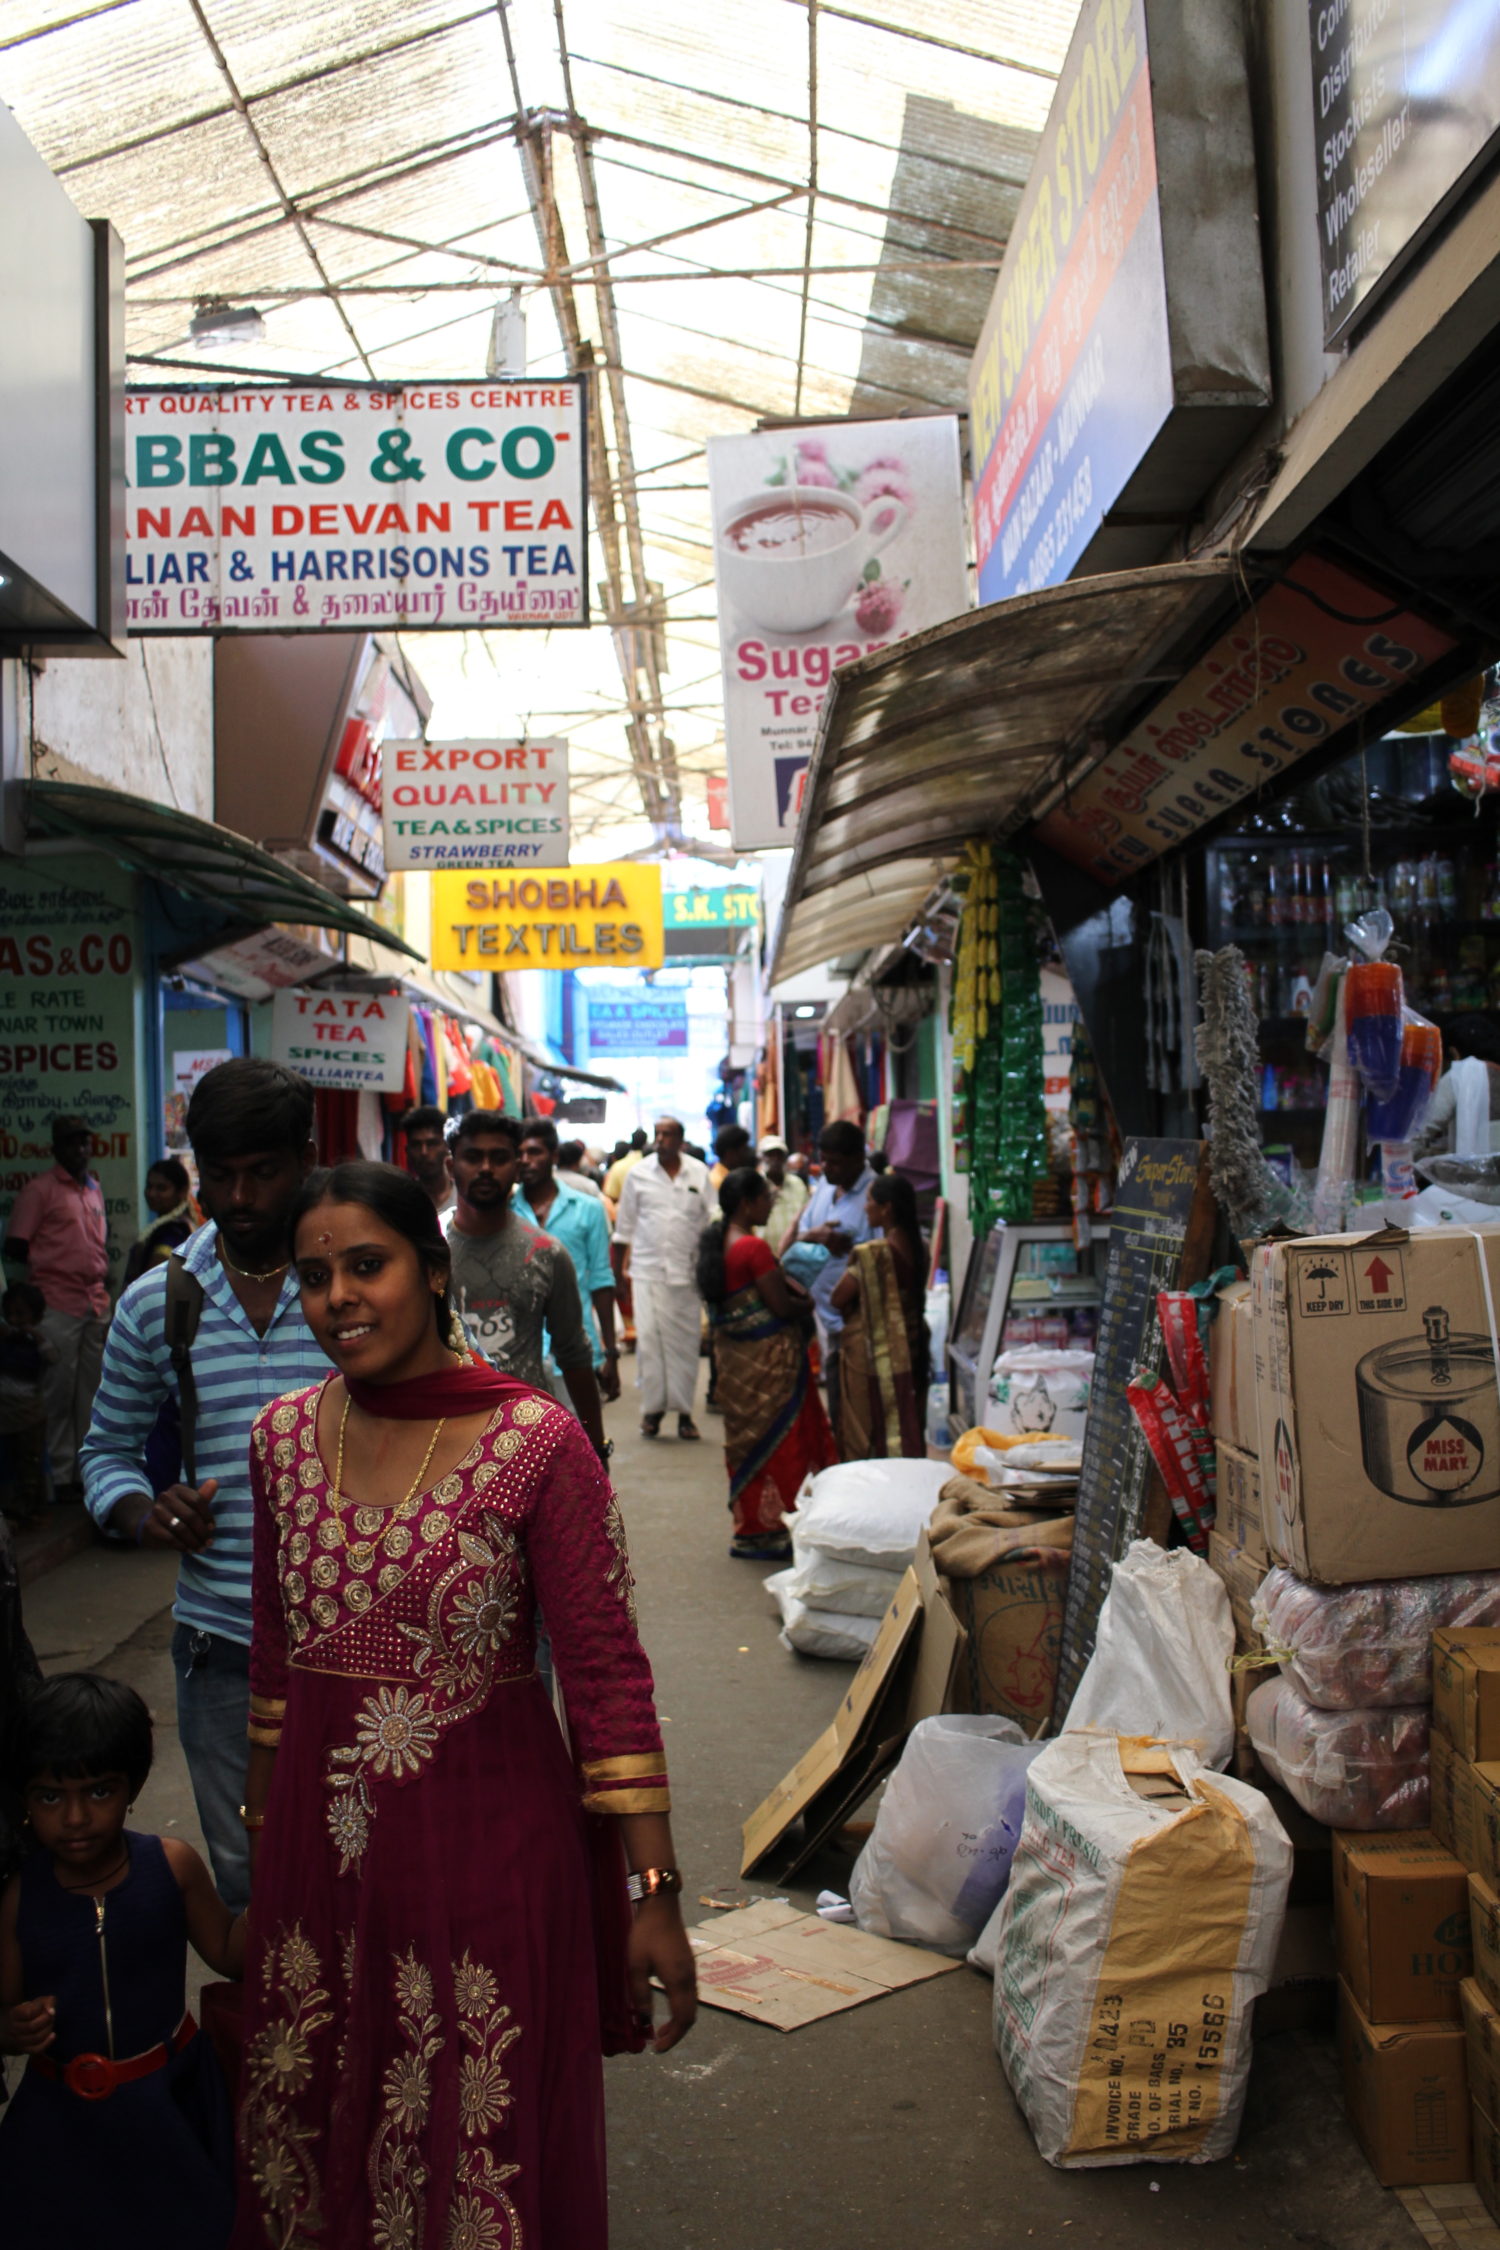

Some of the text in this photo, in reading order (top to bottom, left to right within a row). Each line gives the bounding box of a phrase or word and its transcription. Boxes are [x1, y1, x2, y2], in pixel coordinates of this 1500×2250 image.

[1323, 65, 1386, 182] Stockists
[1329, 219, 1382, 313] Retailer
[1001, 174, 1057, 396] SUPER
[159, 394, 276, 414] QUALITY
[282, 393, 334, 412] TEA
[343, 393, 361, 411] &
[370, 391, 461, 410] SPICES
[470, 388, 574, 408] CENTRE
[126, 431, 346, 488] BBAS
[369, 428, 426, 483] &
[126, 499, 575, 539] NAN DEVAN TEA
[228, 549, 255, 582] &
[271, 545, 489, 581] HARRISONS
[502, 544, 576, 576] TEA
[292, 584, 310, 616] &
[760, 725, 808, 737] Munnar
[1145, 767, 1251, 839] SUPER
[1240, 632, 1422, 770] STORES
[396, 747, 555, 772] EXPORT
[392, 782, 558, 807] QUALITY
[410, 843, 543, 860] STRAWBERRY
[437, 859, 515, 870] GREEN TEA
[466, 878, 628, 911] SHOBHA
[452, 923, 645, 956] TEXTILES
[31, 990, 86, 1008] RATE
[294, 997, 386, 1019] TATA
[45, 1015, 103, 1032] TOWN
[312, 1023, 367, 1042] TEA
[0, 1043, 118, 1074] SPICES
[288, 1047, 386, 1063] SPICES
[1306, 1300, 1344, 1312] KEEP DRY
[1359, 1298, 1404, 1310] THIS SIDE UP
[1426, 1439, 1465, 1454] MISS
[1424, 1456, 1467, 1471] MARY
[1149, 2053, 1166, 2087] BAGS
[1169, 2063, 1184, 2085] NO.
[1106, 2081, 1121, 2140] INVOICE
[1149, 2092, 1161, 2111] OF
[1127, 2092, 1141, 2140] GRADE
